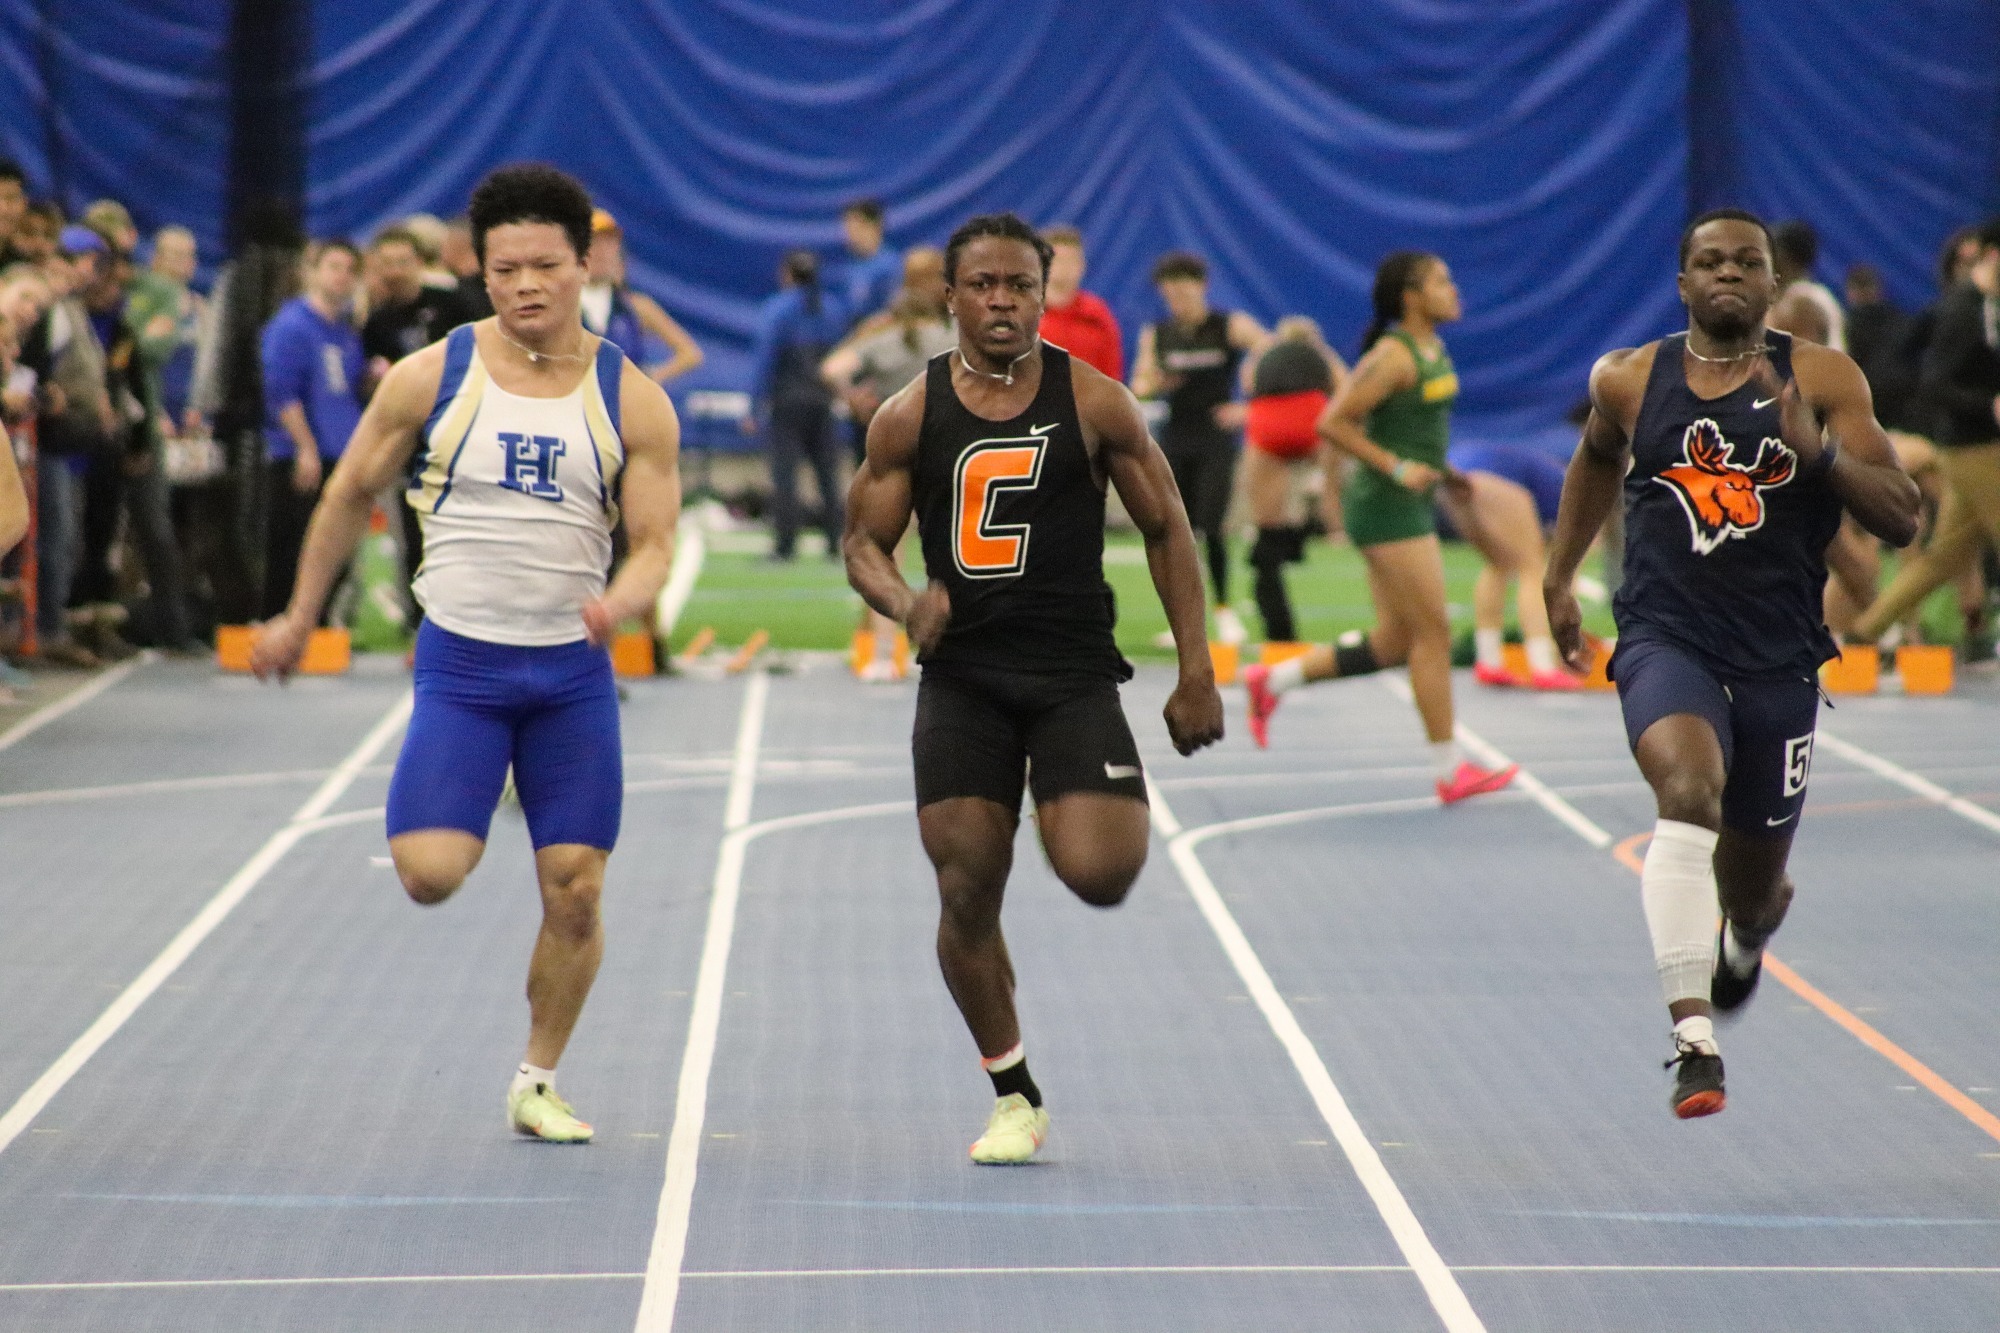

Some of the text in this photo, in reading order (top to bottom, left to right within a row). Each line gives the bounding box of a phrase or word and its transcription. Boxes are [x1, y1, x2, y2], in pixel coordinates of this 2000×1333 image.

[497, 432, 566, 503] H
[953, 436, 1049, 579] C
[1789, 739, 1809, 789] 5
